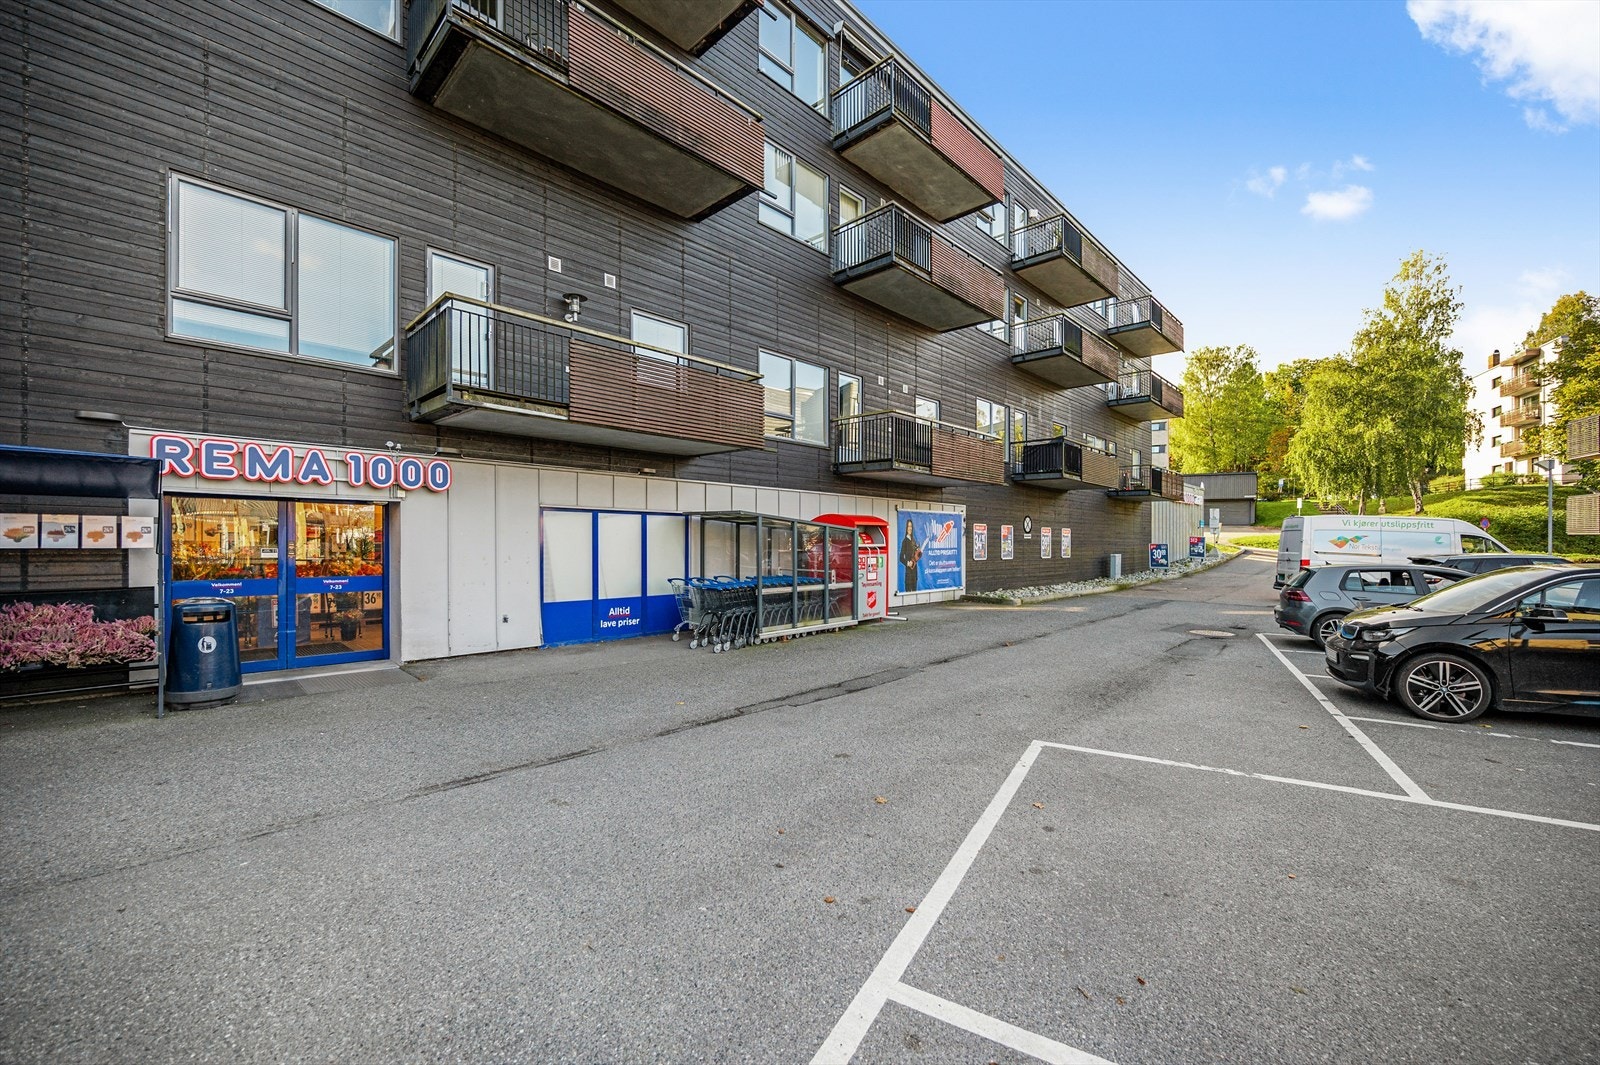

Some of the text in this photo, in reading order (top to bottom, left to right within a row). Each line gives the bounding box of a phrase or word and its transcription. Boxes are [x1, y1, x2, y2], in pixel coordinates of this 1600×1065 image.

[150, 434, 452, 491] REMA 1000
[1342, 519, 1434, 529] Vi kjører utslippsfritt
[1152, 549, 1161, 558] 30
[364, 593, 376, 604] 36
[609, 606, 630, 616] Alltid
[600, 617, 640, 628] lave priser
